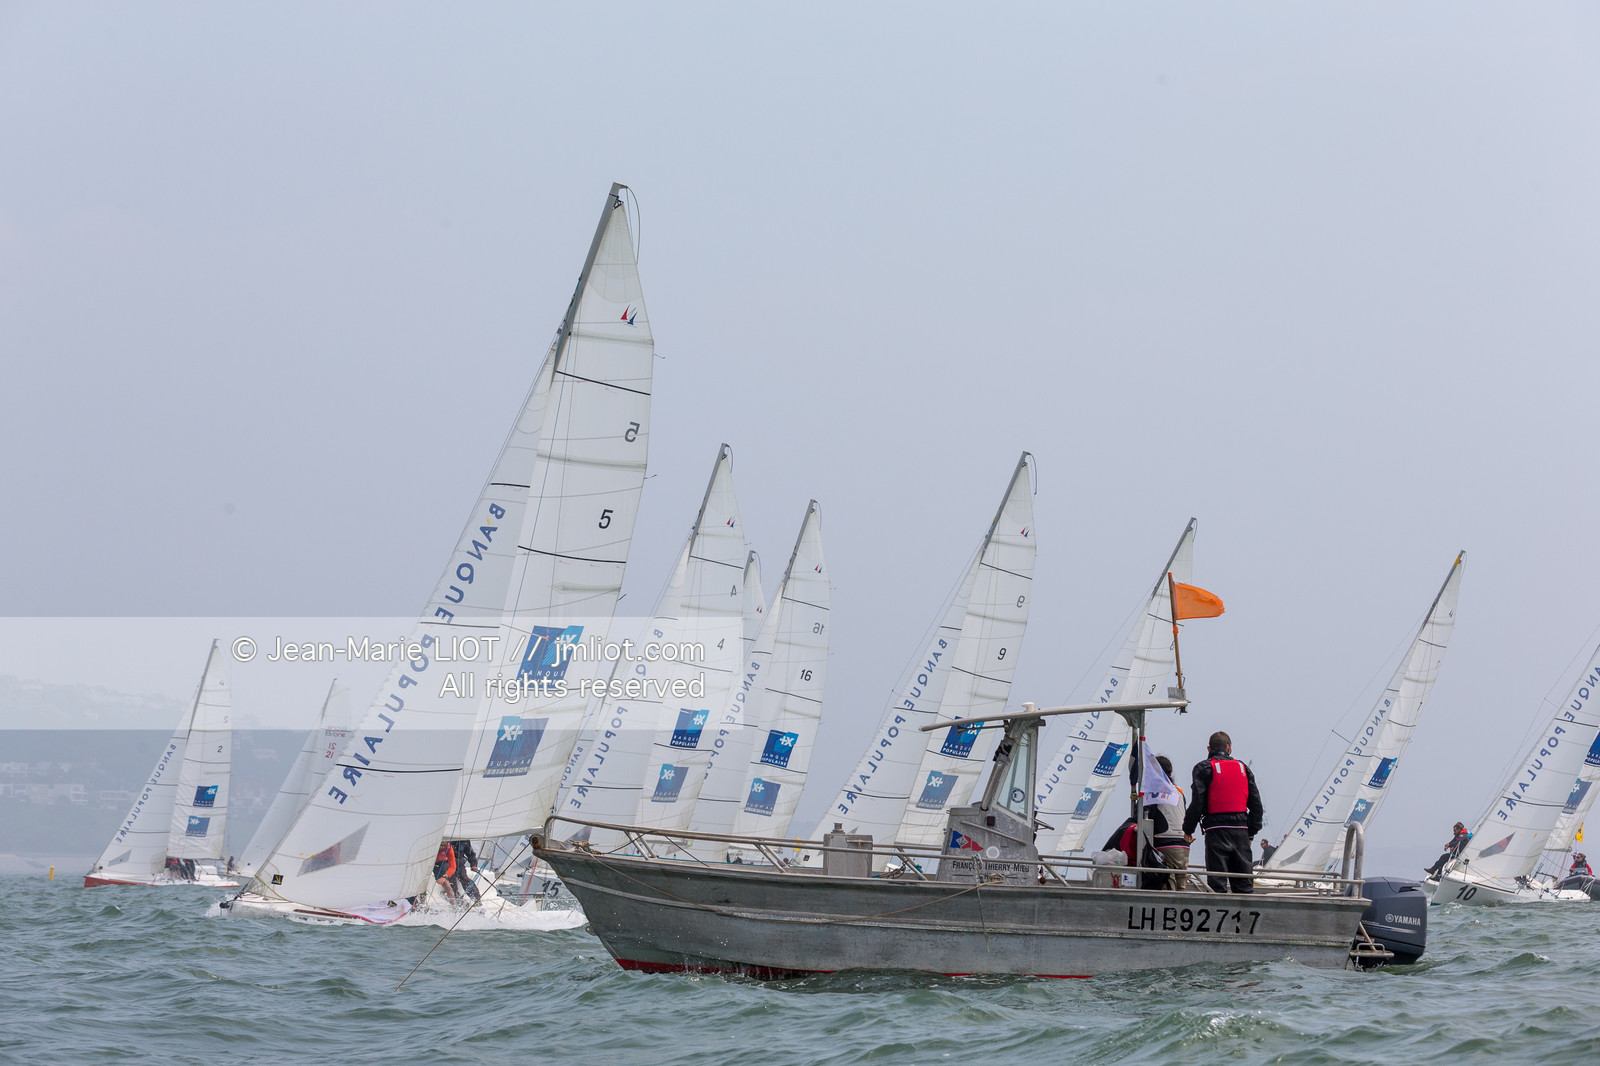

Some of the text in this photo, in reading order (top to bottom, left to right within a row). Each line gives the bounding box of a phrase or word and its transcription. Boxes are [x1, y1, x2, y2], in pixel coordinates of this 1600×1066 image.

[598, 508, 614, 529] 5
[717, 638, 725, 650] 4
[997, 647, 1007, 661] 9
[520, 669, 565, 677] BANQUE
[800, 669, 813, 682] 16
[1148, 684, 1157, 695] 3
[217, 745, 223, 753] 2
[541, 880, 562, 898] 15
[1456, 885, 1478, 901] 10
[1128, 906, 1156, 931] LH
[1394, 915, 1421, 926] YAMAHA
